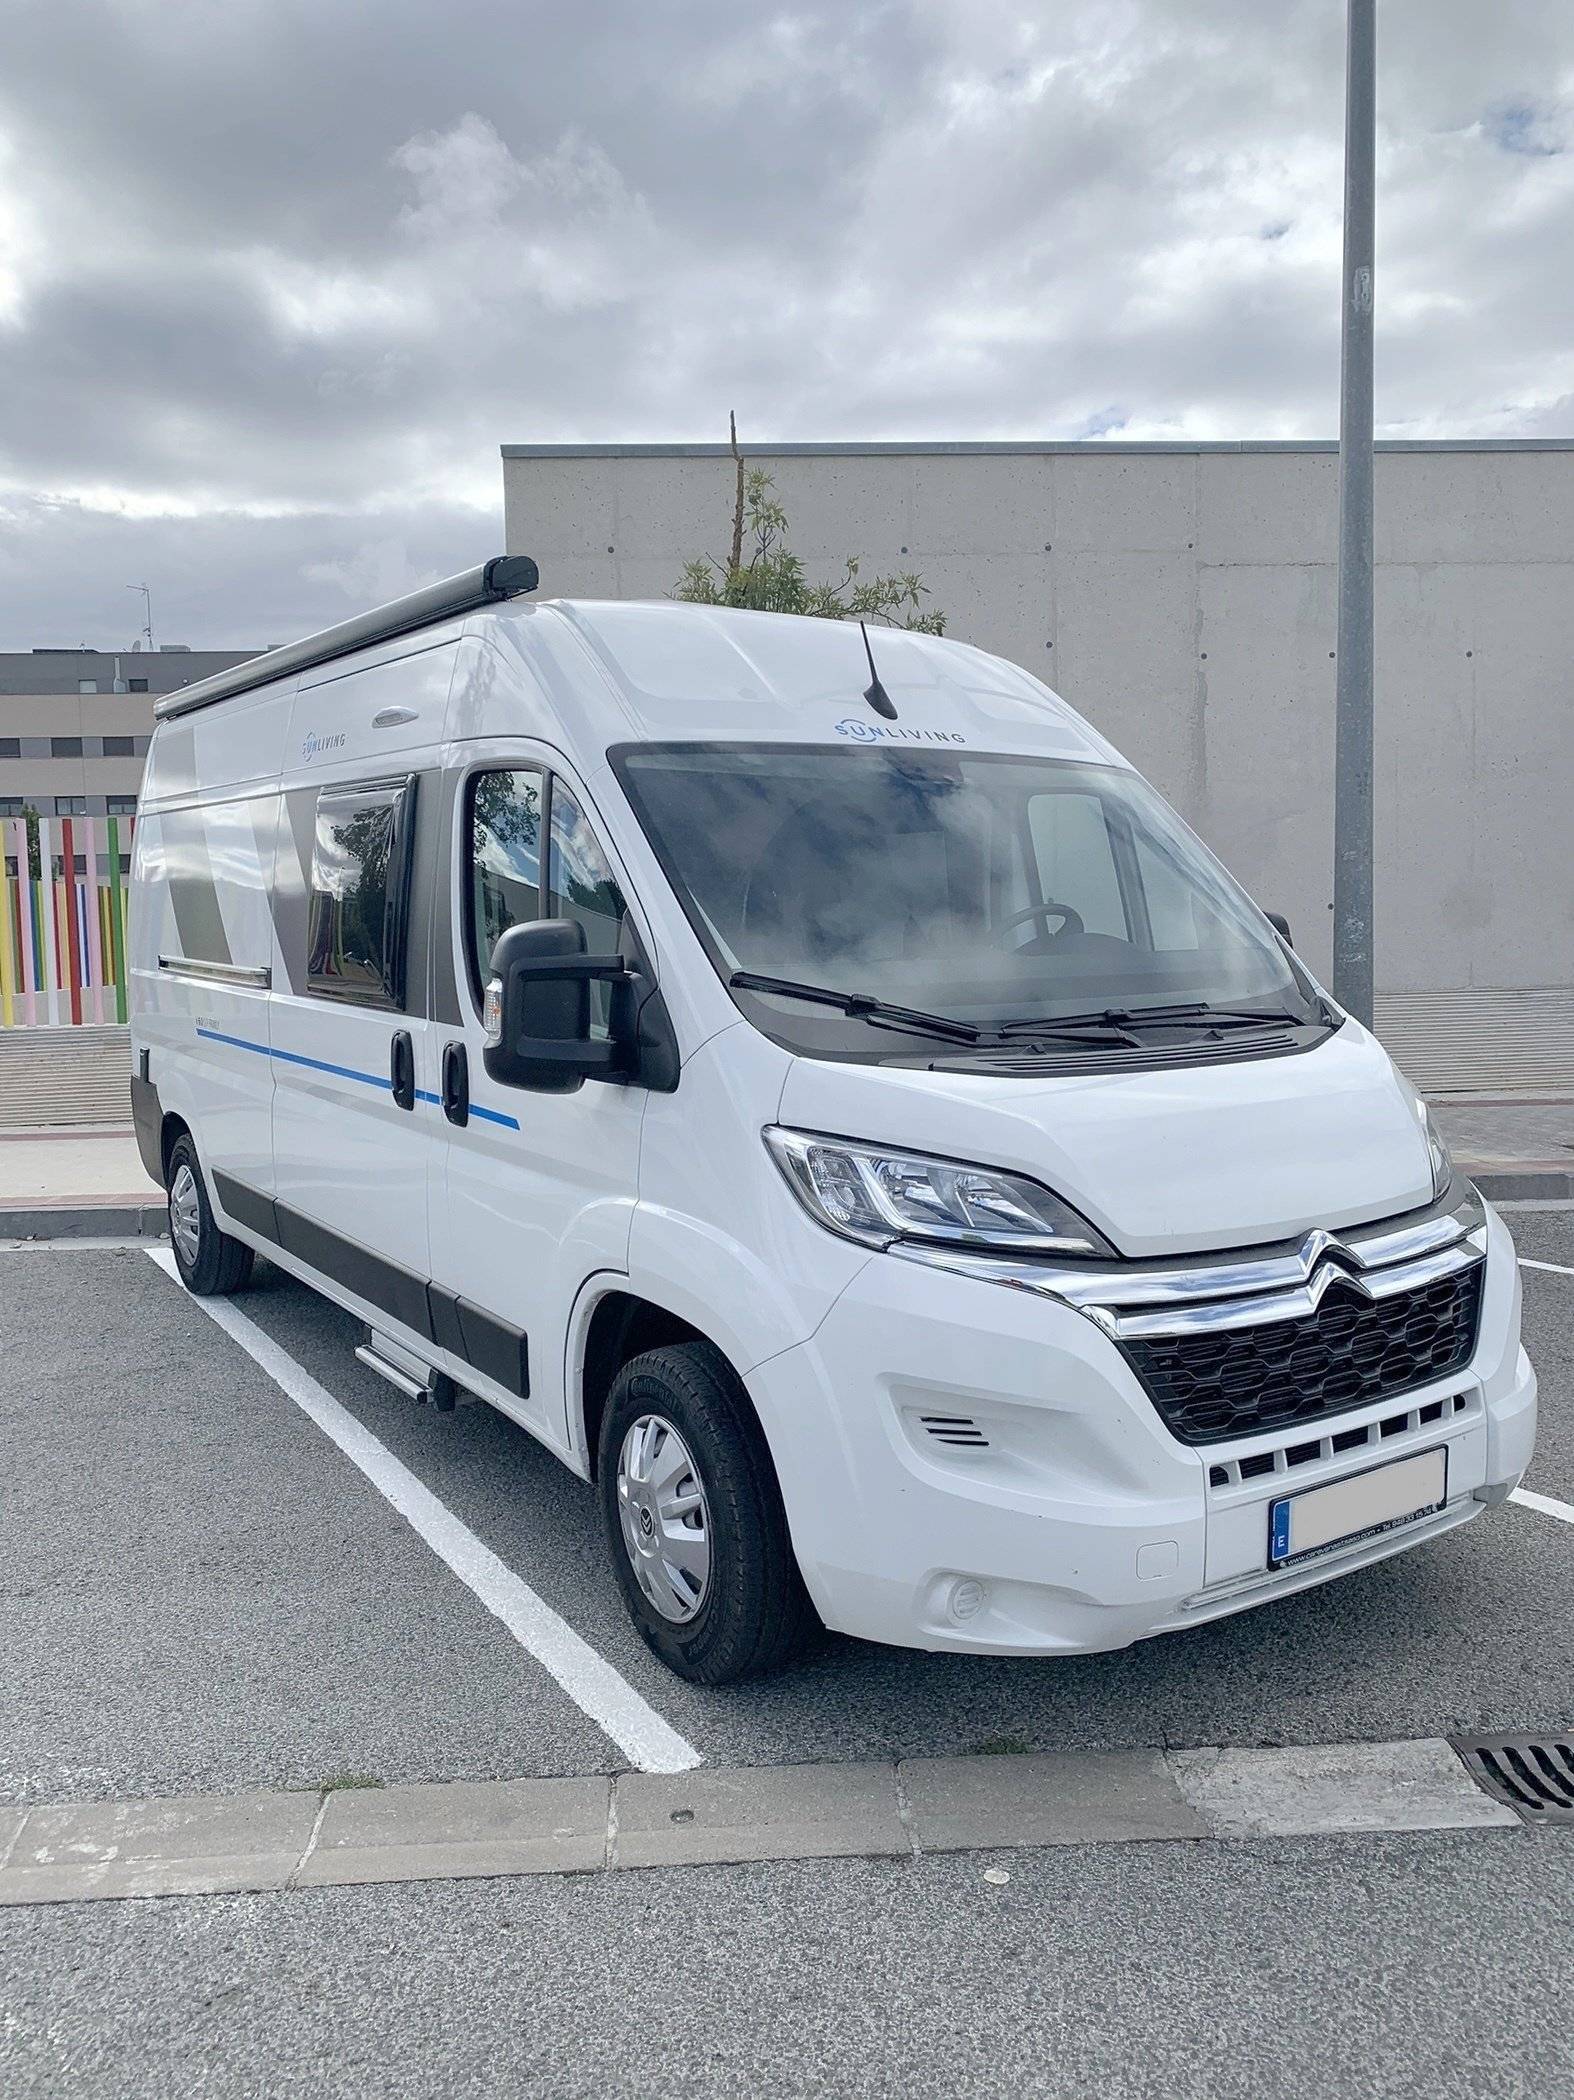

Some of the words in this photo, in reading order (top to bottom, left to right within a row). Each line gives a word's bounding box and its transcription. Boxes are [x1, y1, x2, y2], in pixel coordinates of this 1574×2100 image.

[302, 733, 346, 755] SUNLIVING
[834, 722, 966, 744] SUNLIVING
[1277, 1534, 1286, 1549] E
